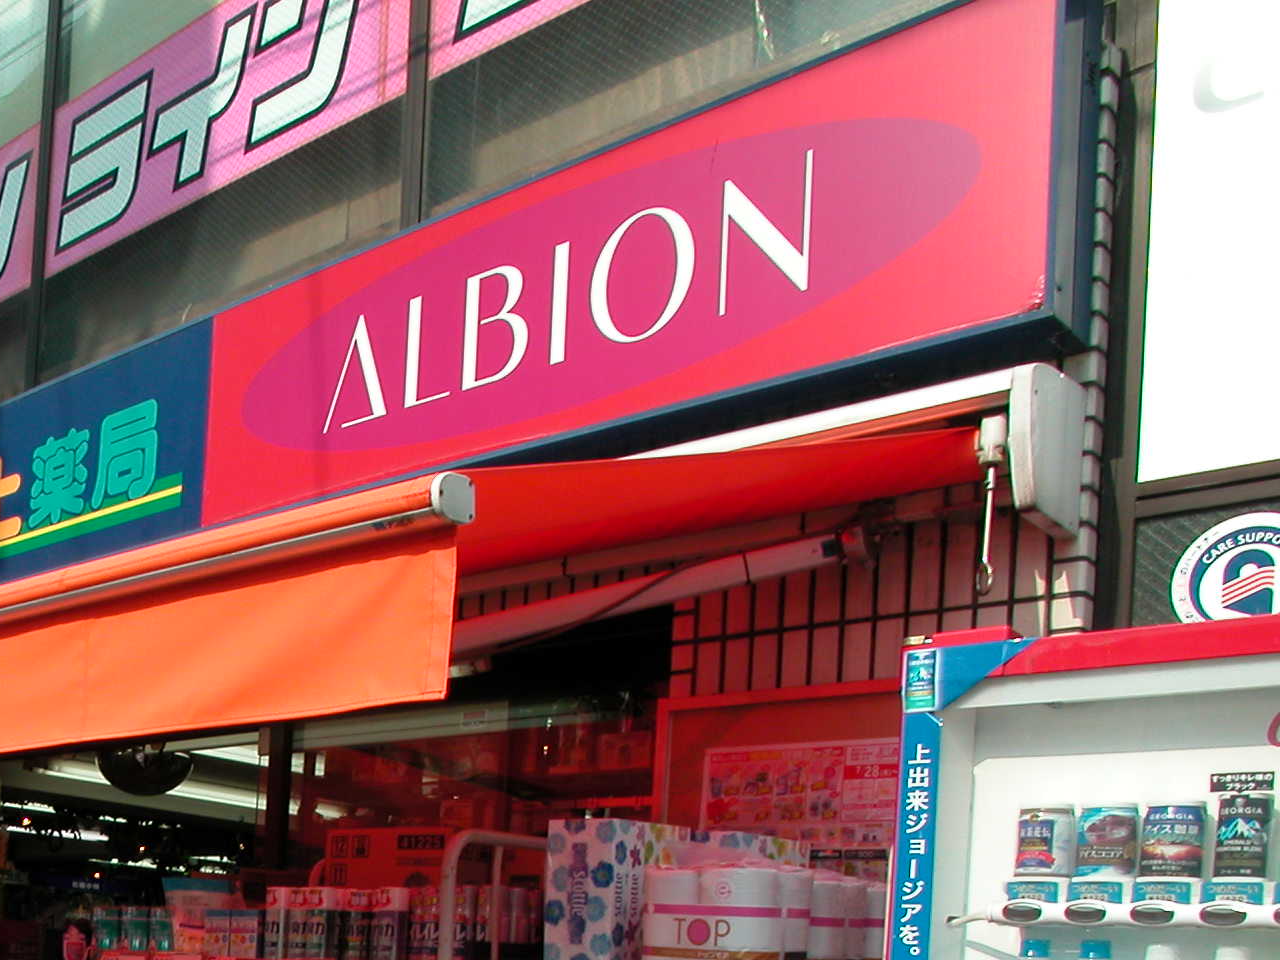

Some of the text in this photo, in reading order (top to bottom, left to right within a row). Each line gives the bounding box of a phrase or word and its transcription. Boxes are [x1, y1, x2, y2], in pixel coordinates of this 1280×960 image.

[323, 148, 813, 433] ALBION
[1202, 538, 1236, 564] CARE
[899, 743, 931, 956] 上出来ジョージアを。
[571, 870, 586, 917] scottie
[673, 918, 731, 947] TOP
